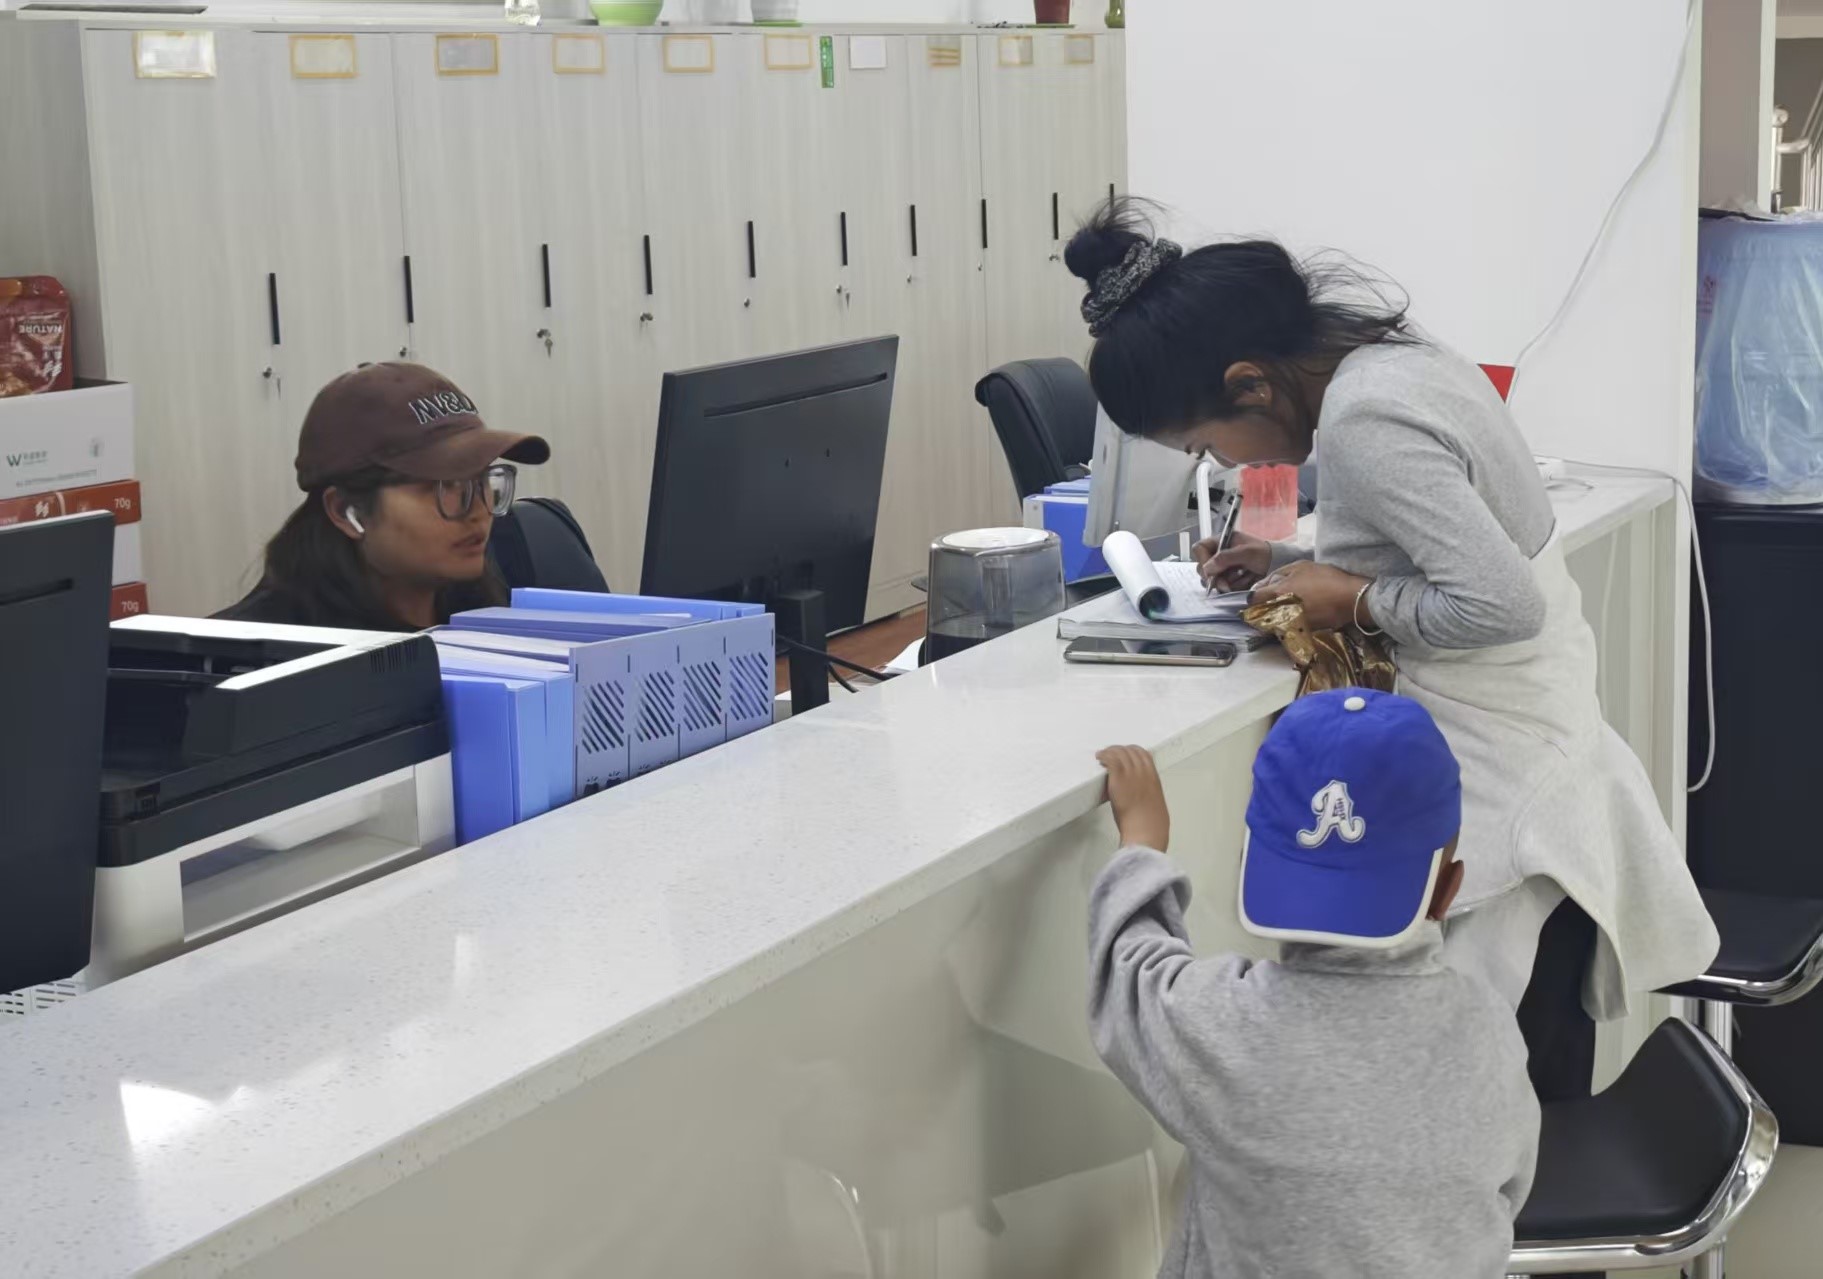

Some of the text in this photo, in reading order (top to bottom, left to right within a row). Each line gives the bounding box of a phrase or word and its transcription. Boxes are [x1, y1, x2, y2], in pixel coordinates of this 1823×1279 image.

[18, 323, 63, 334] NATURE
[114, 497, 132, 510] 70g
[121, 600, 140, 613] 70g
[1296, 779, 1366, 849] A
